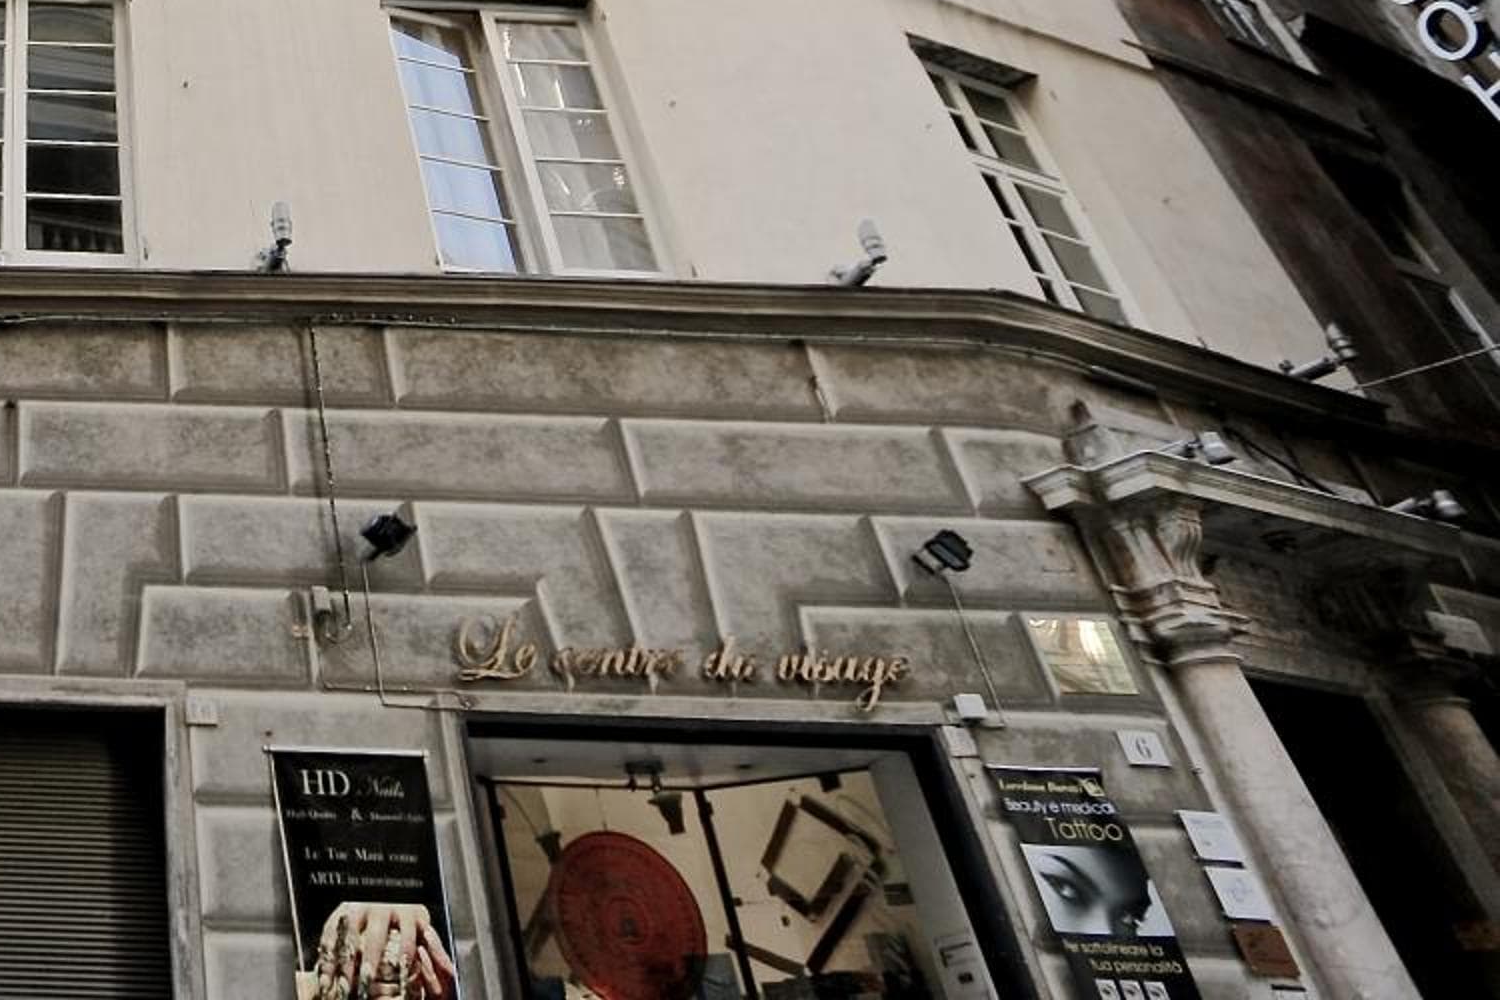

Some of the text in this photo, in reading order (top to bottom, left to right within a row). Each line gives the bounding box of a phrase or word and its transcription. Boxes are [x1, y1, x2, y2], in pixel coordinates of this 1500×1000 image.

[456, 612, 537, 681] Le
[704, 636, 756, 679] du
[778, 649, 911, 712] visage
[300, 769, 350, 796] HD
[1044, 815, 1124, 842] Tattoo
